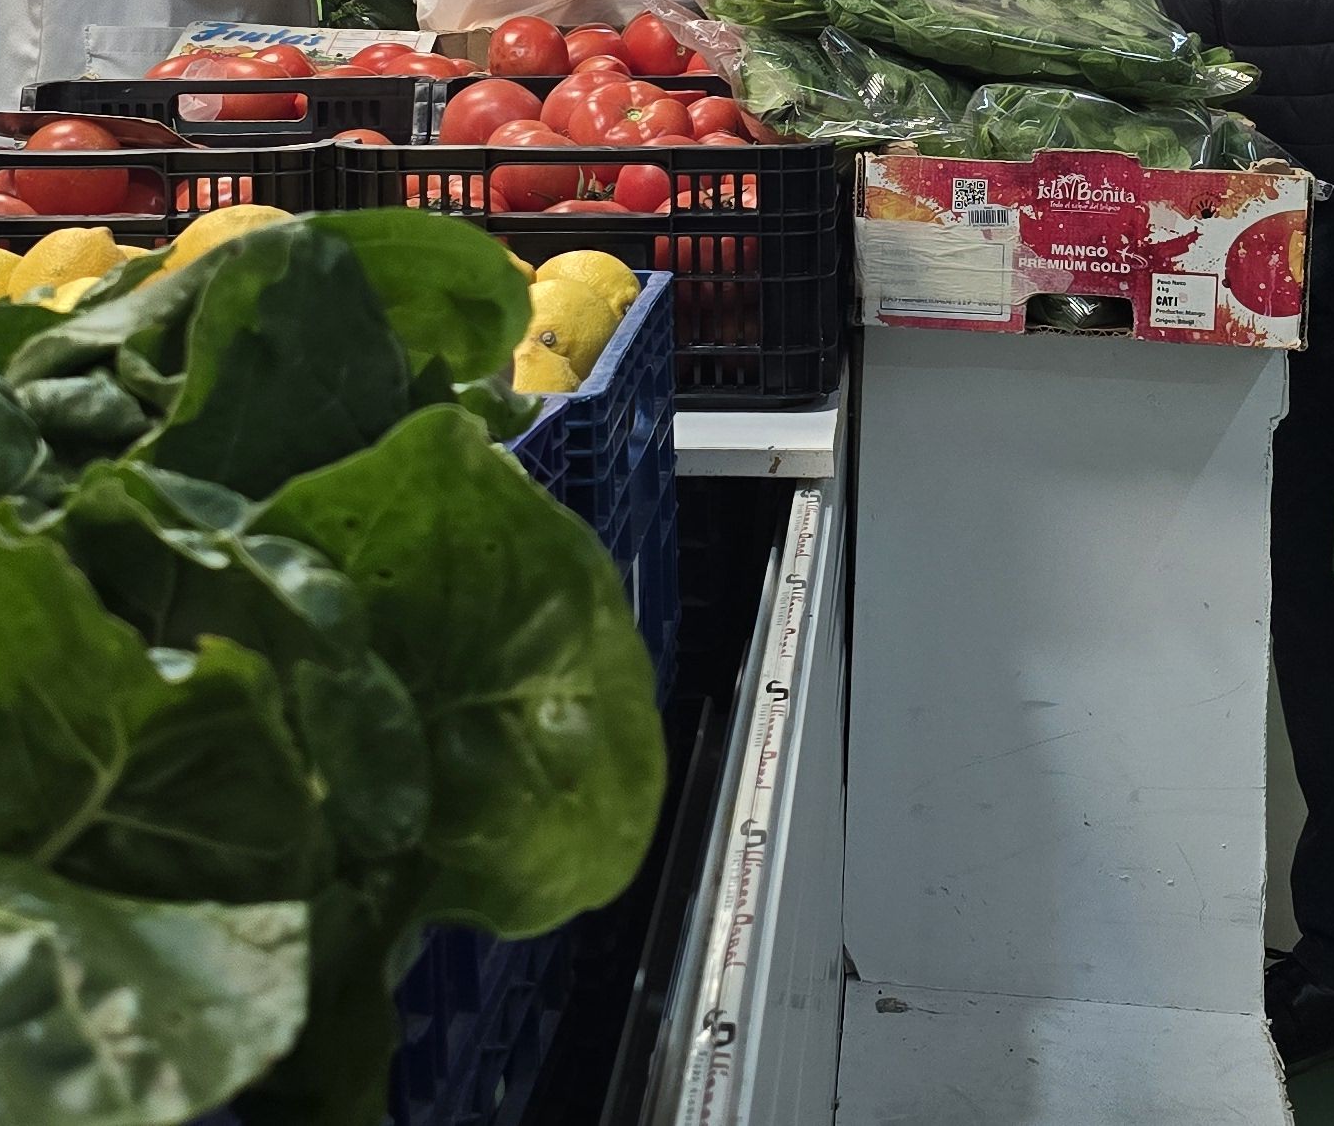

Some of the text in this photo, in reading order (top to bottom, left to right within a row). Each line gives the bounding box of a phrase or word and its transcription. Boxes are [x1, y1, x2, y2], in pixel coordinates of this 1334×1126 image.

[1077, 180, 1135, 203] Bonita
[1051, 244, 1108, 258] MANGO
[1019, 258, 1131, 274] PREMIUM GOLD
